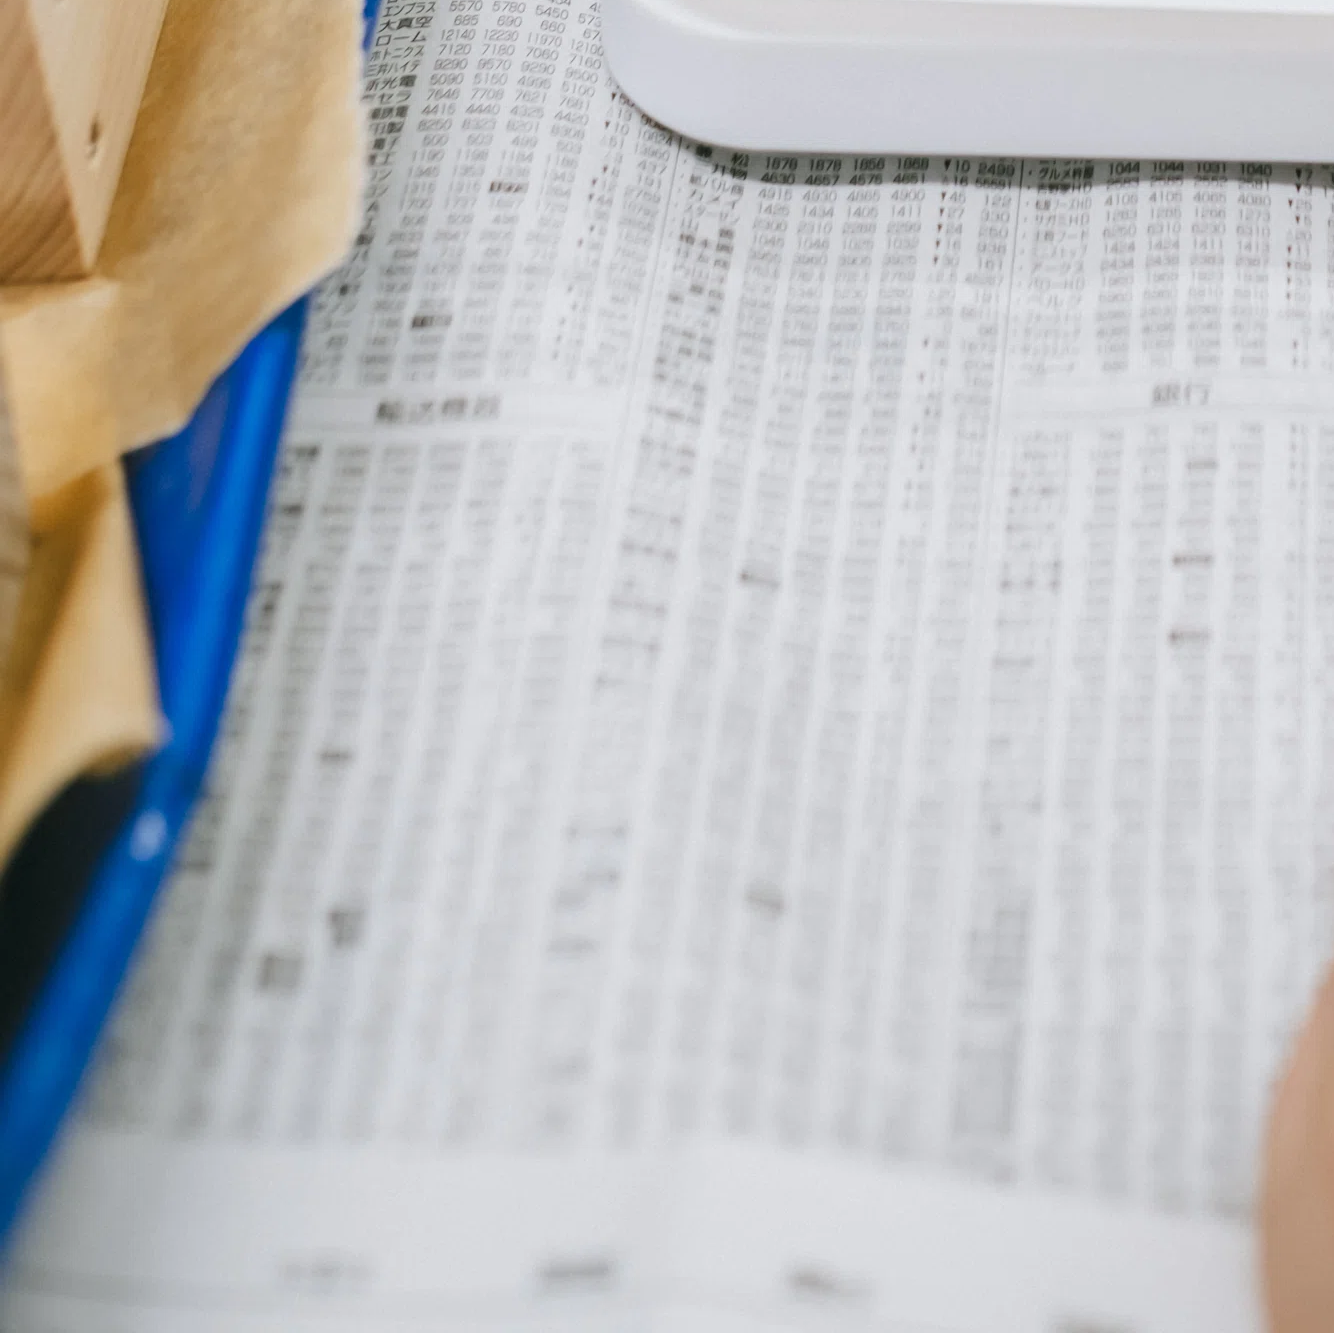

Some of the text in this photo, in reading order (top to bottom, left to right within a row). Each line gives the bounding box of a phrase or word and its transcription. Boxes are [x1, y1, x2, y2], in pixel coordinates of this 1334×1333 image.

[382, 0, 569, 20] エンプラス 5570 5780 5450
[378, 16, 433, 32] 大真空
[375, 31, 426, 47] ローム
[440, 29, 476, 41] 12140
[438, 44, 472, 56] 7120
